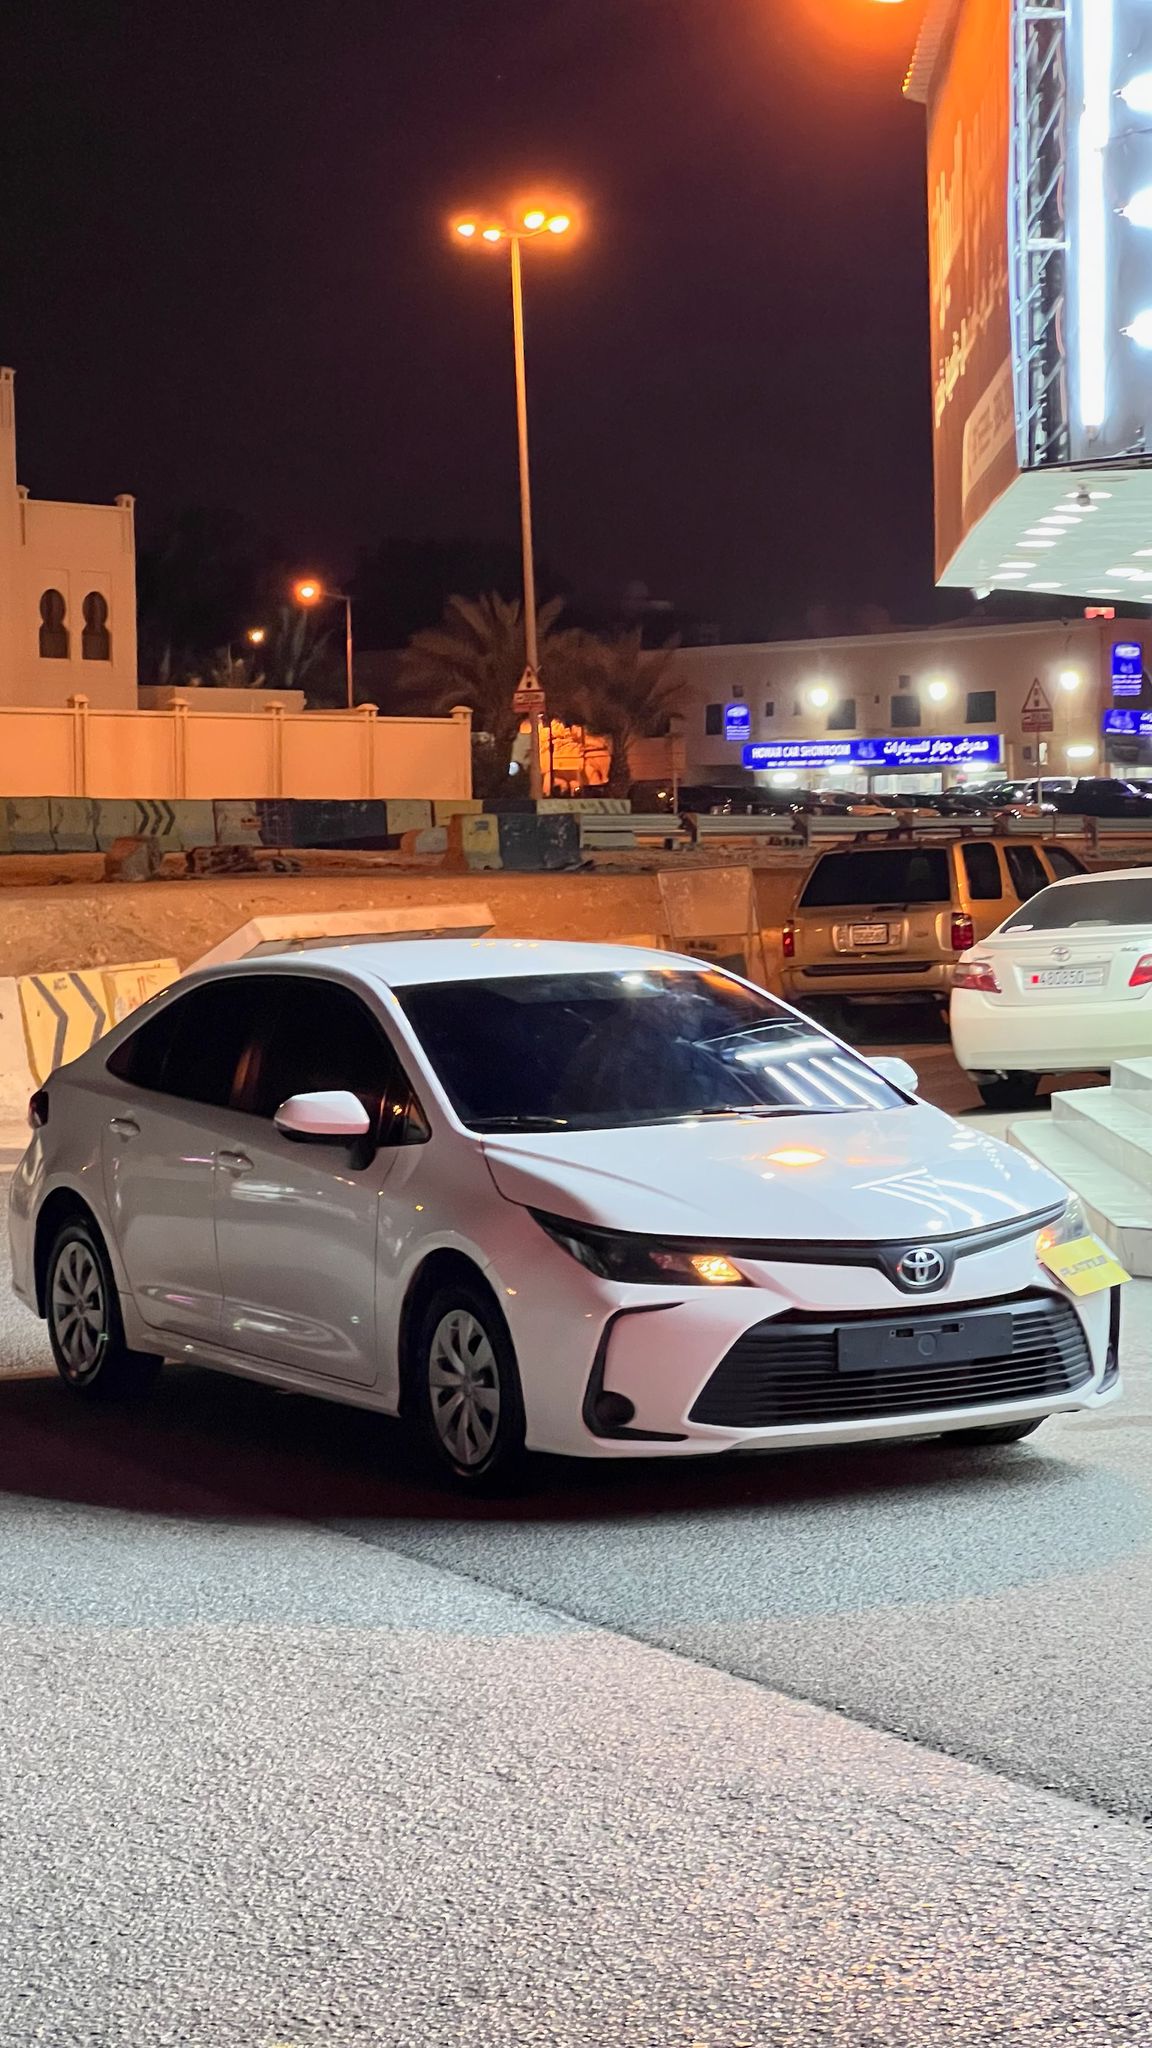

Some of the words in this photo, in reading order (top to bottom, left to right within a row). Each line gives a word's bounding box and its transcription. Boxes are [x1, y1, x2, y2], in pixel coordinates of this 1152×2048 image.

[783, 745, 800, 758] CAR
[800, 744, 851, 757] SHOWROOM
[883, 740, 930, 757] للسيارات
[954, 738, 989, 755] معرض
